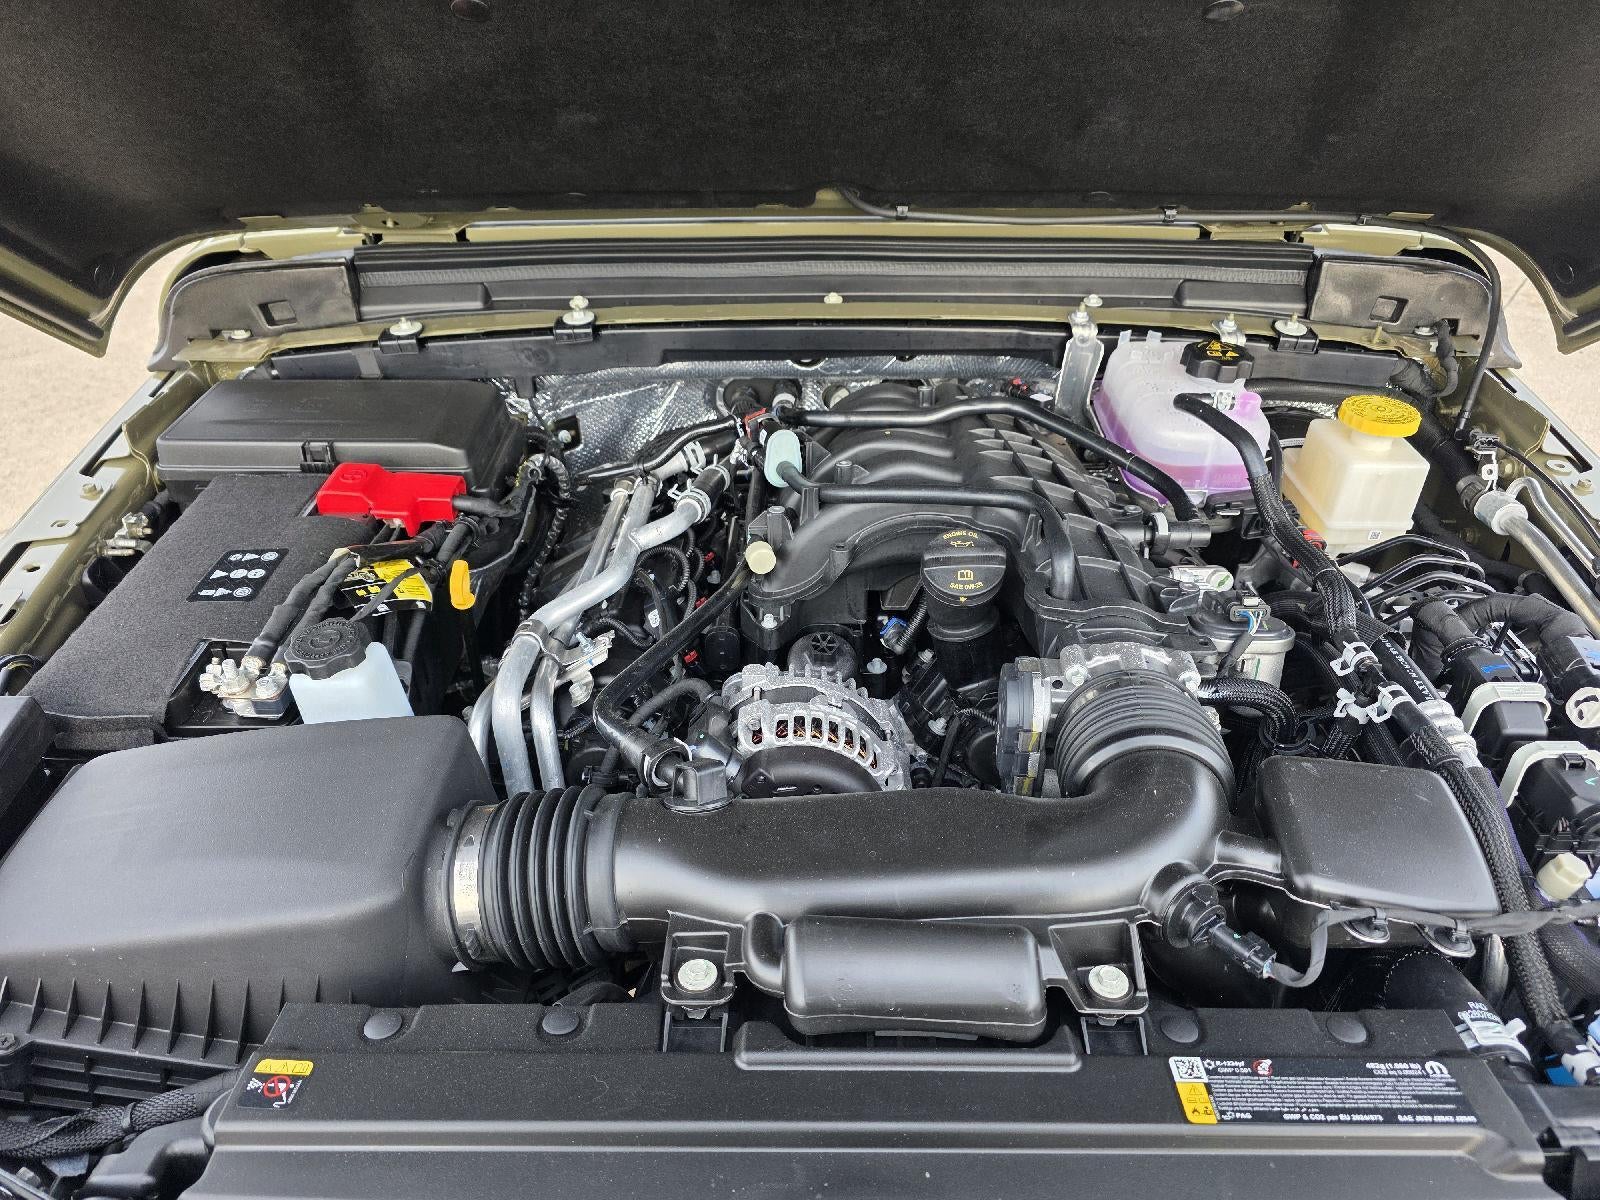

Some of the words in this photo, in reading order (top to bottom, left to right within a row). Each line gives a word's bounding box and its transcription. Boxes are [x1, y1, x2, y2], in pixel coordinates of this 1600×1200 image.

[942, 530, 967, 540] ENGINE
[968, 531, 979, 539] OIL
[950, 582, 964, 590] SAE
